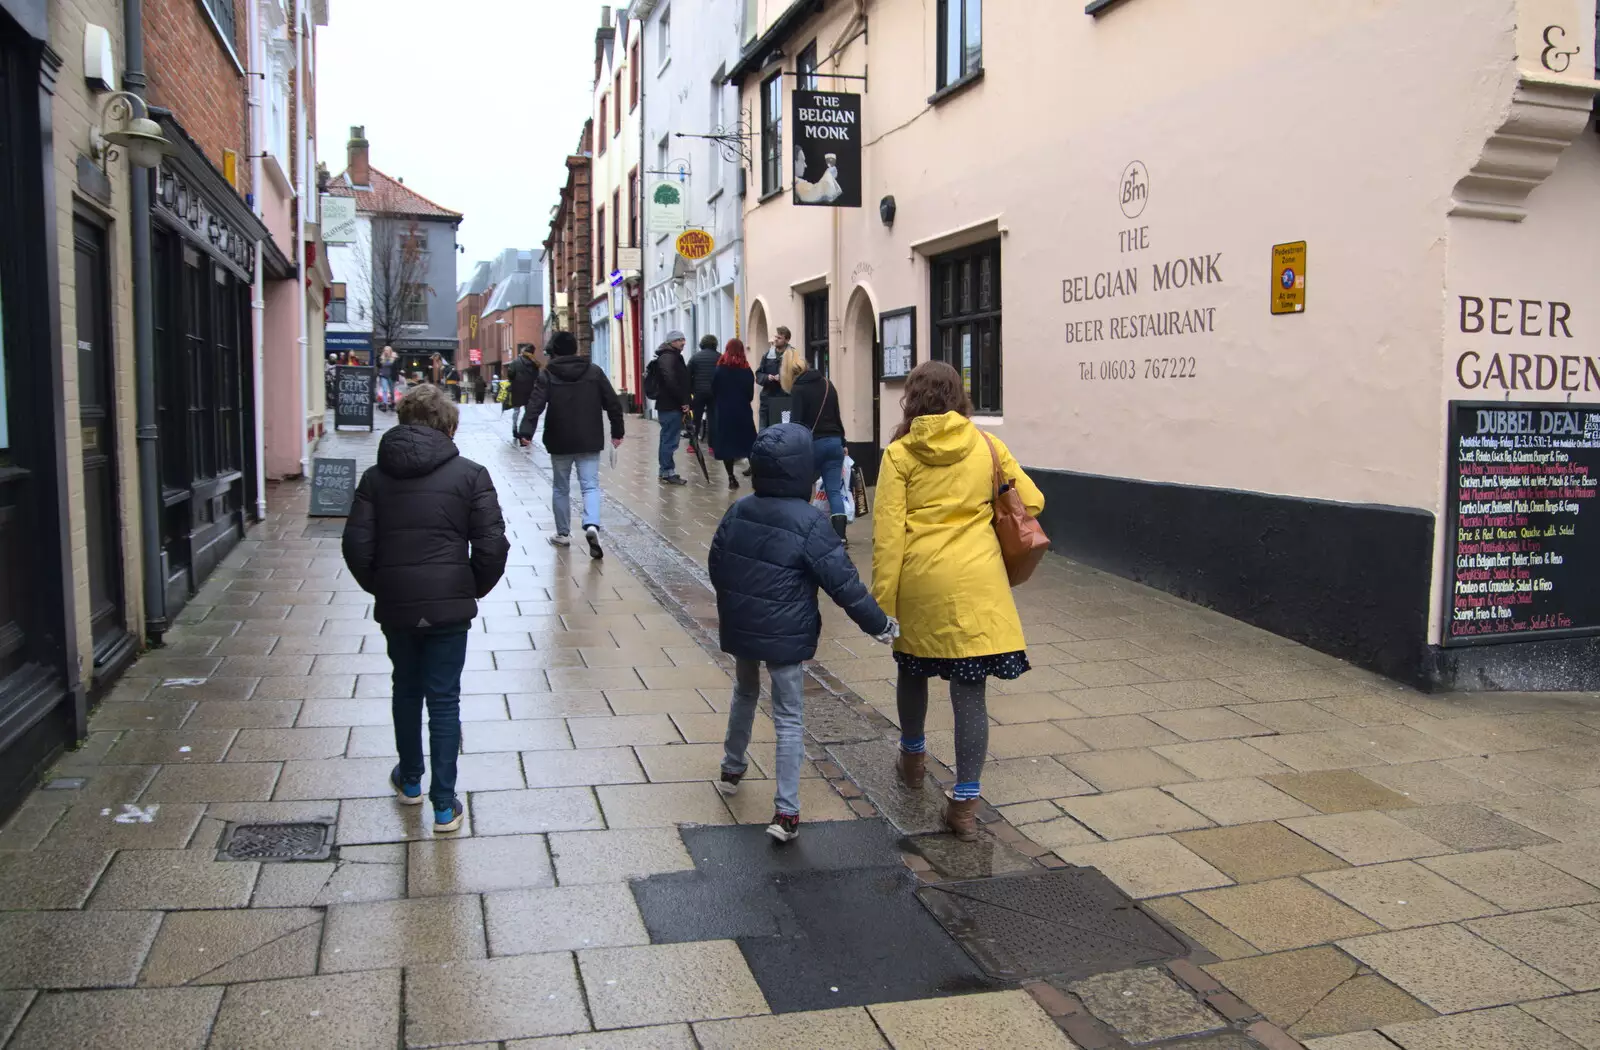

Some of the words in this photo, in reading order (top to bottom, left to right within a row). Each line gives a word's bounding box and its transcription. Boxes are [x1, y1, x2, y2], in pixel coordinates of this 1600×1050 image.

[1540, 25, 1580, 73] &
[814, 96, 840, 107] THE
[799, 108, 855, 124] BELGIAN
[805, 125, 849, 140] MONK
[1118, 225, 1150, 253] THE
[680, 244, 710, 258] PANTRY
[1281, 255, 1296, 264] Zone
[1062, 267, 1138, 304] BELGIAN
[1152, 252, 1223, 292] MONK
[1459, 295, 1574, 339] BEER
[1065, 320, 1104, 344] BEER
[1110, 307, 1217, 340] RESTAURANT
[1100, 359, 1136, 380] 01603
[1144, 356, 1197, 379] 767222
[1456, 350, 1600, 393] GARDEN
[338, 404, 368, 416] COFFEE
[1476, 410, 1536, 434] DUBBEL
[1540, 411, 1583, 434] DEAL
[1459, 449, 1475, 462] Sweet
[318, 463, 350, 475] DRUG
[315, 476, 352, 489] STORE
[1459, 528, 1473, 541] Brie
[1474, 529, 1480, 540] &
[1482, 527, 1494, 540] Red
[1497, 527, 1517, 539] Onion
[1521, 525, 1541, 538] Quiche
[1543, 524, 1557, 537] with
[1559, 523, 1575, 535] Salad
[1457, 554, 1468, 567] Cod
[1469, 555, 1475, 567] in
[1476, 553, 1496, 570] Belgian
[1497, 553, 1511, 566] Beer
[1544, 552, 1550, 564] &
[1533, 579, 1538, 591] &
[1475, 606, 1490, 619] Fries
[1491, 605, 1497, 618] &
